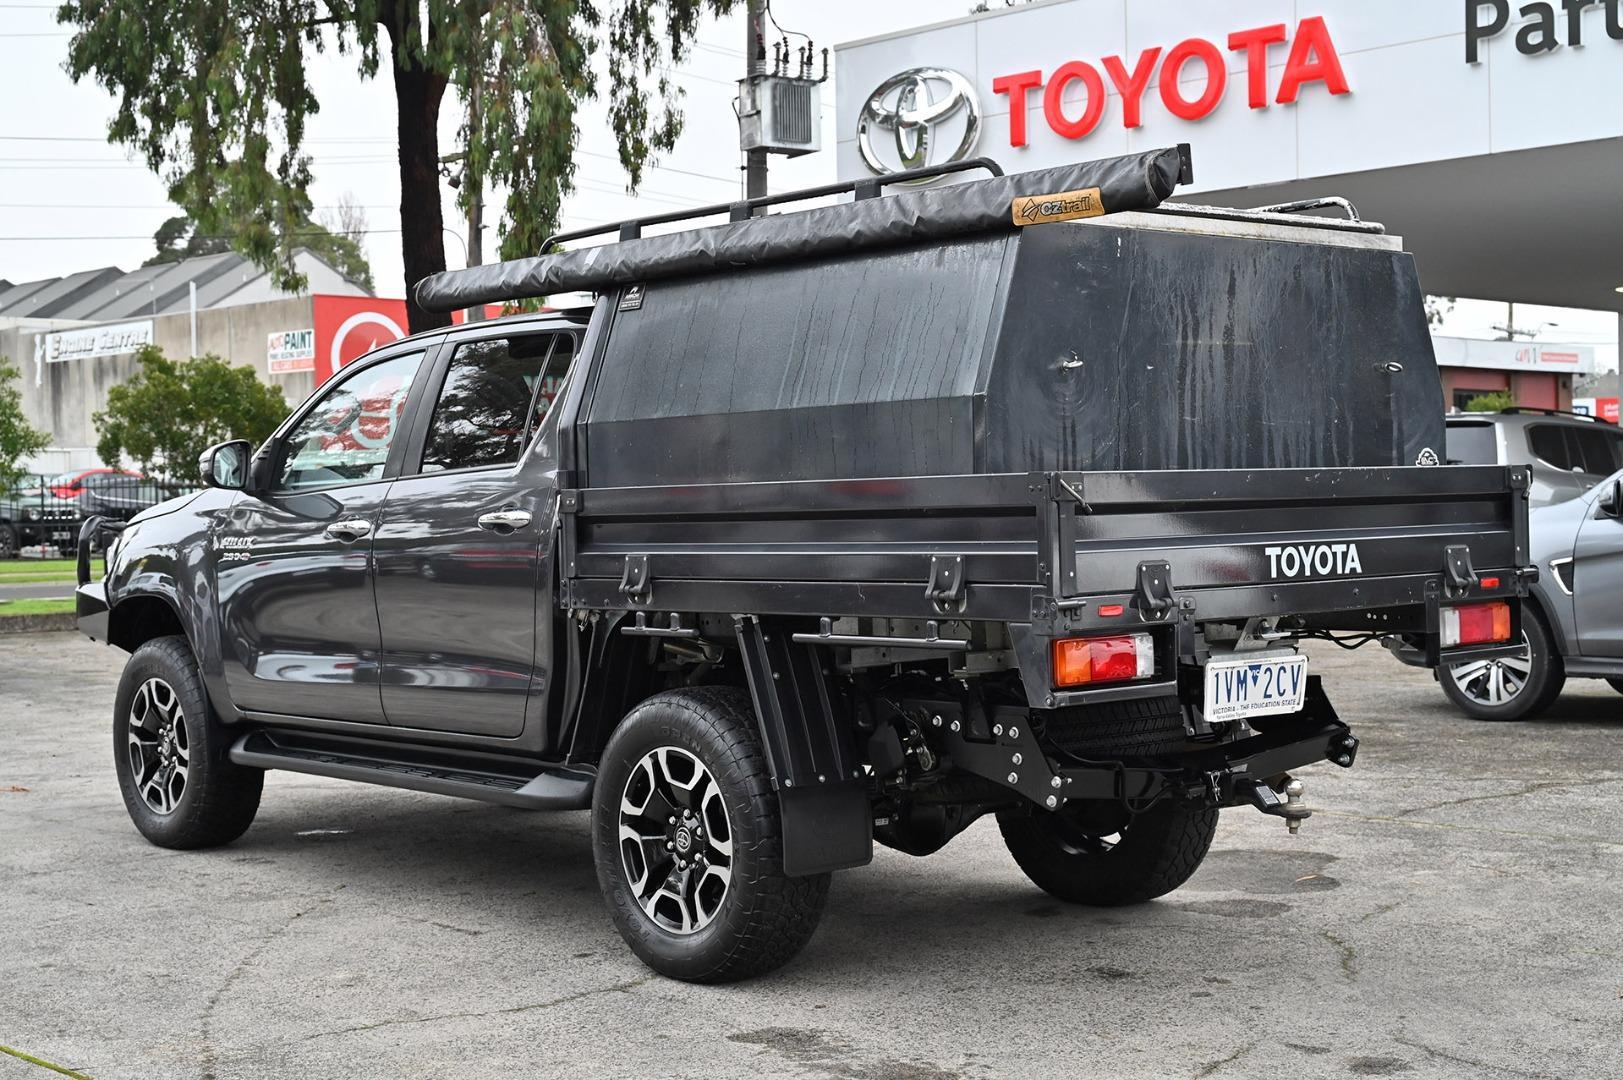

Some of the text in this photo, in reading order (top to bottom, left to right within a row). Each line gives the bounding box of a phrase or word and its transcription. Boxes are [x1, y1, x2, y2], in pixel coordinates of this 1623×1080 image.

[993, 16, 1351, 147] TOYOTA
[284, 330, 312, 350] PAINT
[1265, 543, 1362, 578] TOYOTA
[1213, 706, 1236, 715] VICTORIA
